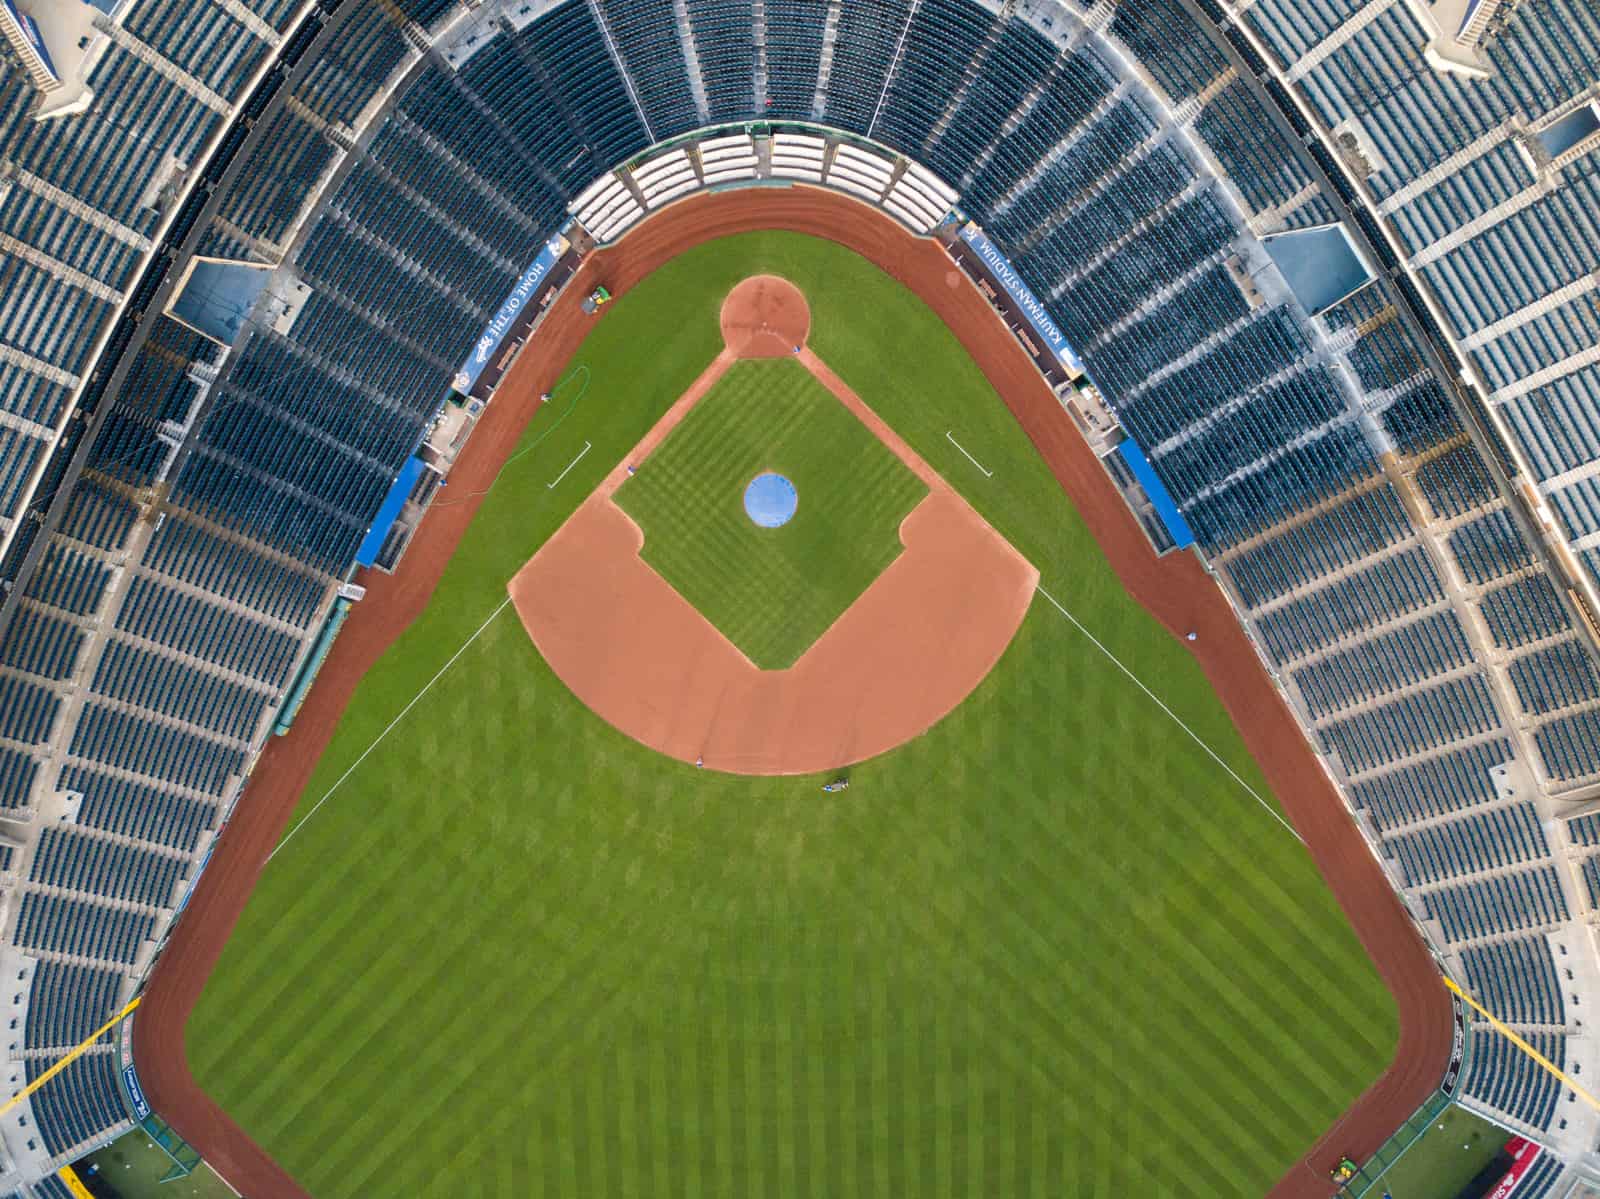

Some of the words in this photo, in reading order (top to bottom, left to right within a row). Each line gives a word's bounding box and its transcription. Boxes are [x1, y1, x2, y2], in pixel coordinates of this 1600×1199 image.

[519, 263, 545, 298] HOME
[980, 241, 1018, 290] STADIUM
[490, 310, 509, 336] THE
[506, 298, 520, 314] OF
[1015, 288, 1063, 344] KAUFFMAN
